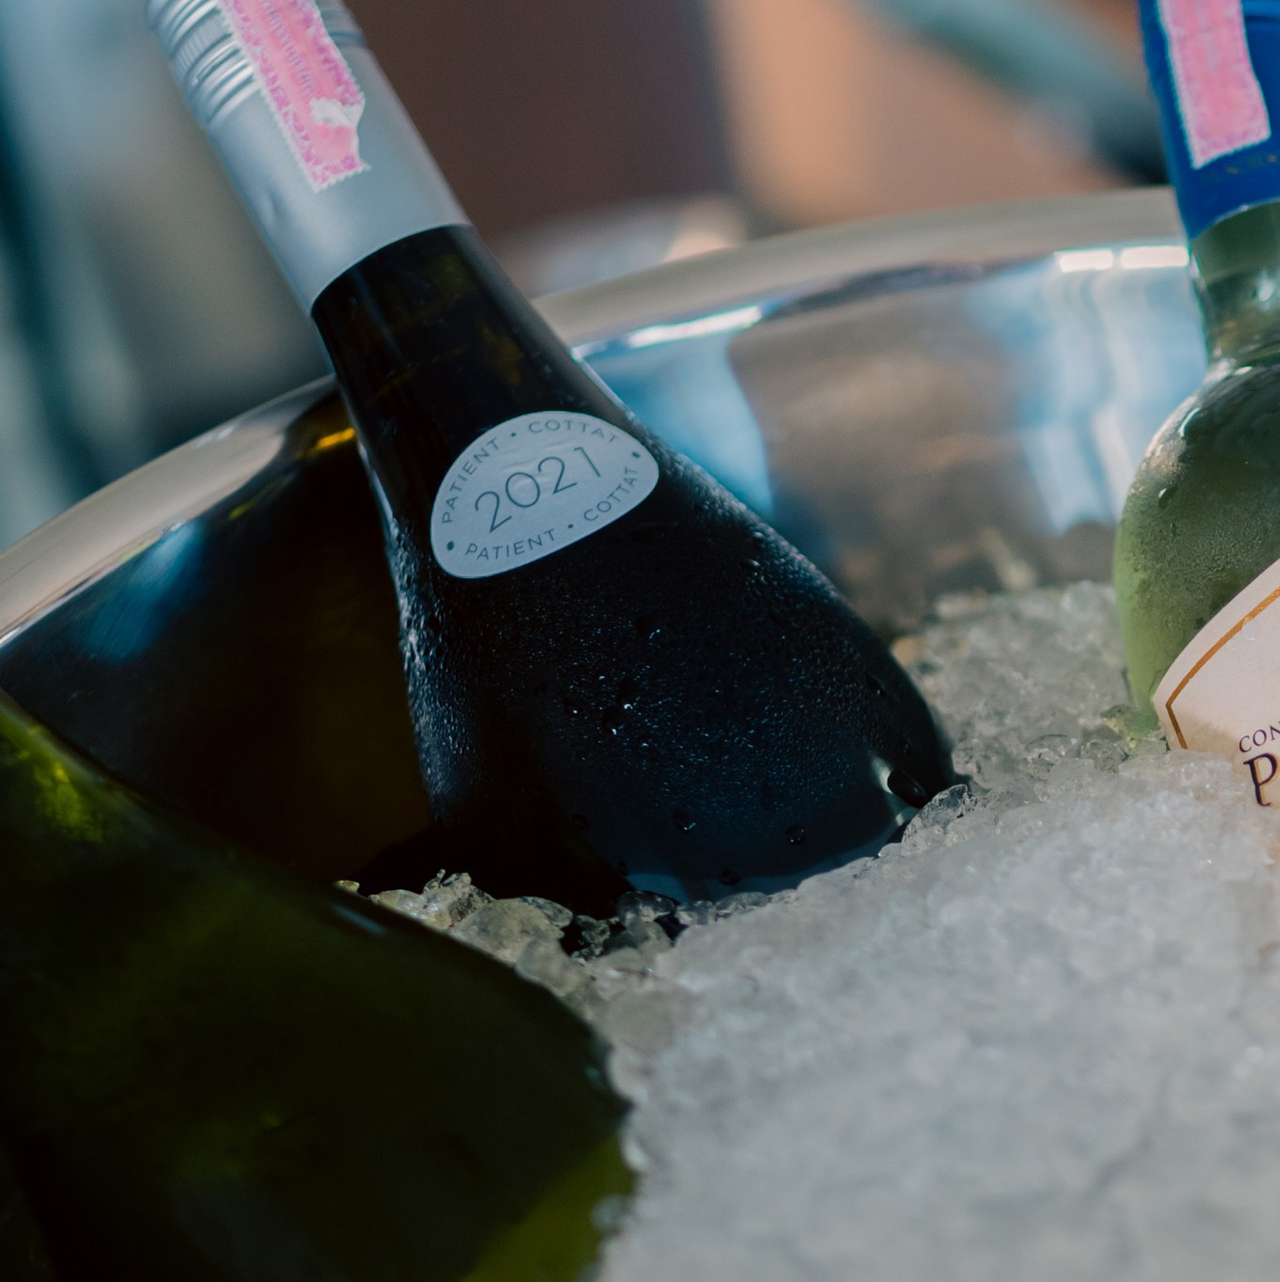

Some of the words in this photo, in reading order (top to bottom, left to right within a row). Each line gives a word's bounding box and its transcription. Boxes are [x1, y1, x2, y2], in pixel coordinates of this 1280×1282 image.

[441, 437, 501, 524] PATIENT
[528, 419, 620, 443] COTTAT
[465, 528, 556, 561] PATIENT
[583, 466, 639, 522] COTTAT
[474, 446, 602, 533] 2021
